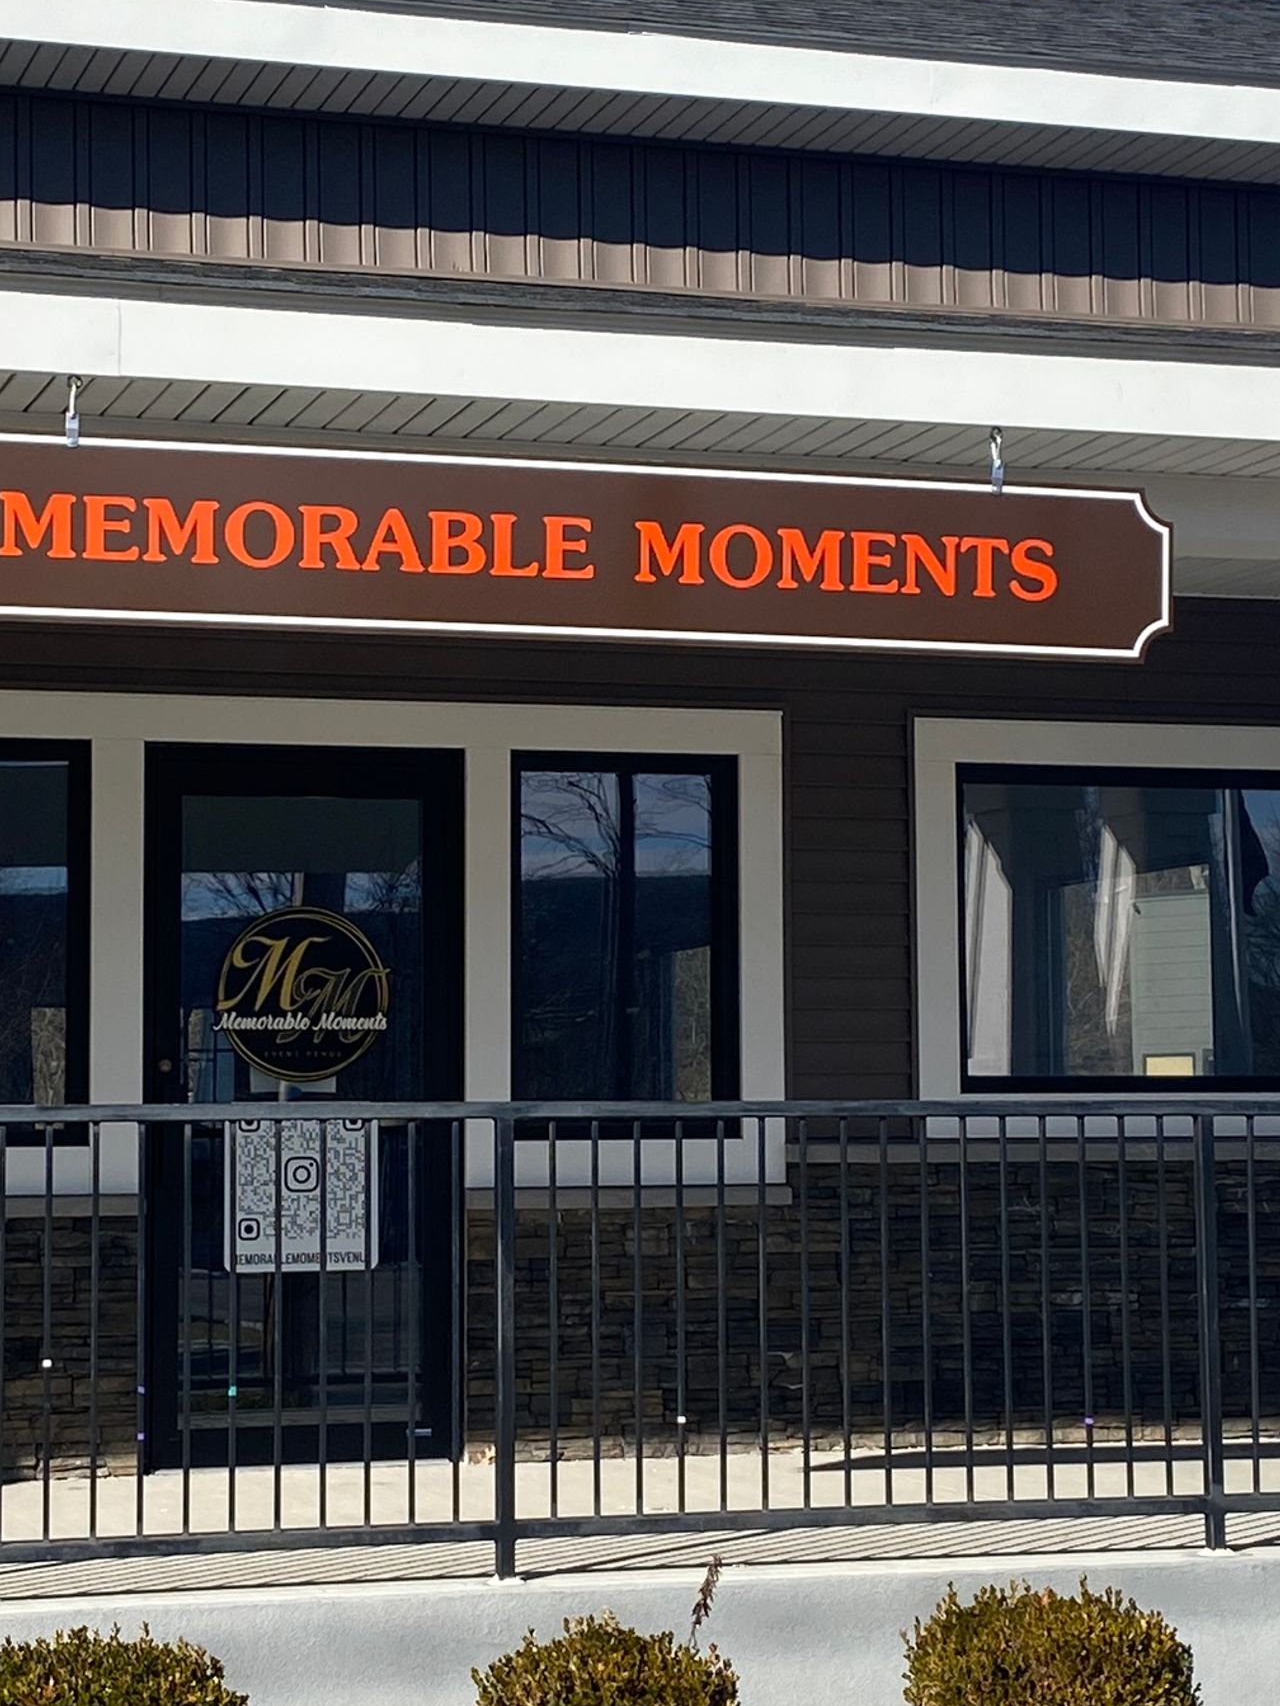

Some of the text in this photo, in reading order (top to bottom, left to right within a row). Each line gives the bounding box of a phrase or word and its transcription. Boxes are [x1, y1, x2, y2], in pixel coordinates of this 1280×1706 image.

[634, 521, 1058, 602] MOMENTS
[212, 1011, 388, 1031] Memorable Moments
